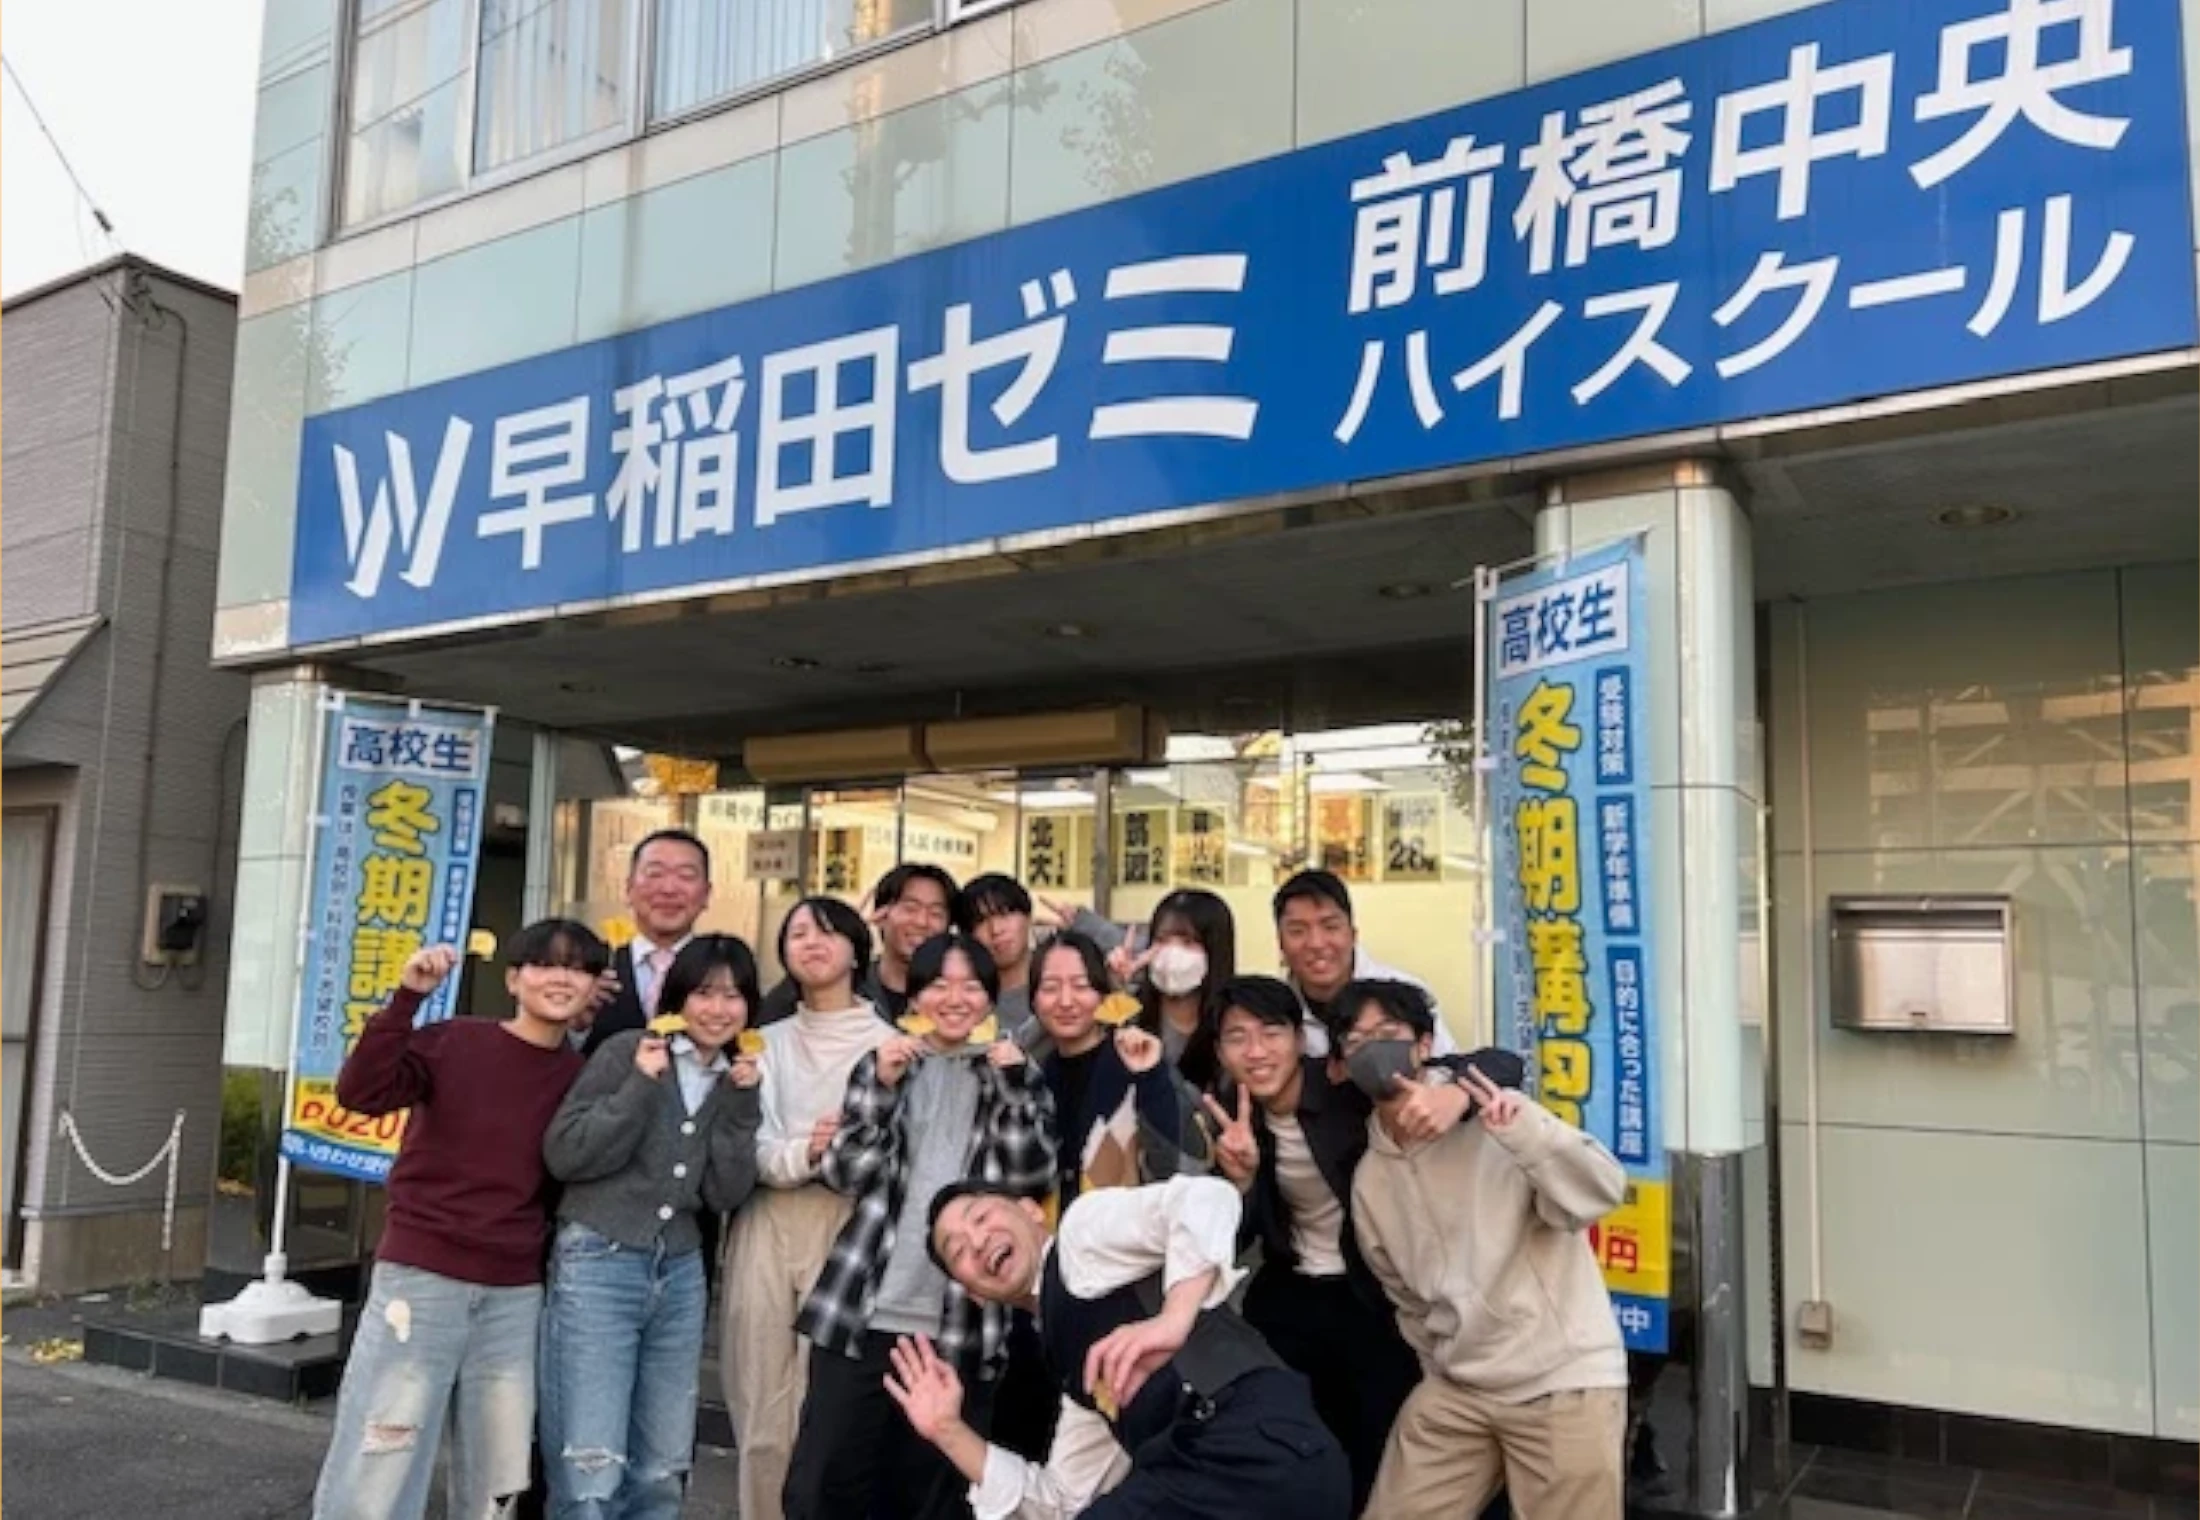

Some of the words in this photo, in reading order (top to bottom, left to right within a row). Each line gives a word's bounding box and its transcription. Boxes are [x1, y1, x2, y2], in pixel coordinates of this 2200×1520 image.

[1346, 0, 2134, 314] 前橋中央
[476, 253, 1258, 570] 早稲田ゼミ
[1334, 194, 2135, 445] ハイスクール
[345, 725, 474, 772] 高校生
[1500, 582, 1617, 664] 高校生
